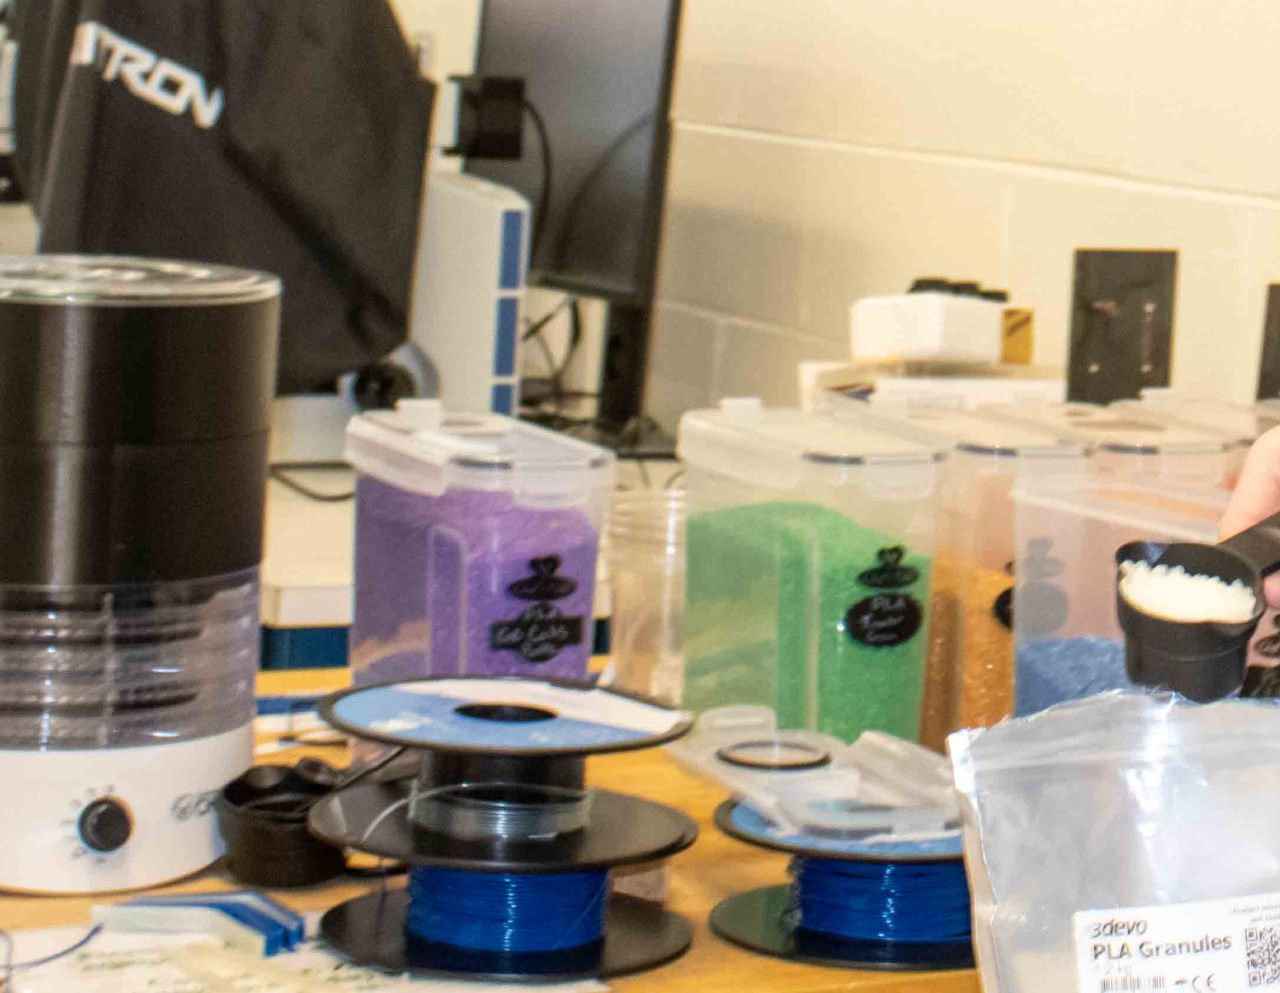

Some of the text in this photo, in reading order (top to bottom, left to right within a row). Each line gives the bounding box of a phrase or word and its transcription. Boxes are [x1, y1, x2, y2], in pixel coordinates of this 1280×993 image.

[1091, 917, 1147, 938] 3devo
[1093, 934, 1233, 960] PLA Granules
